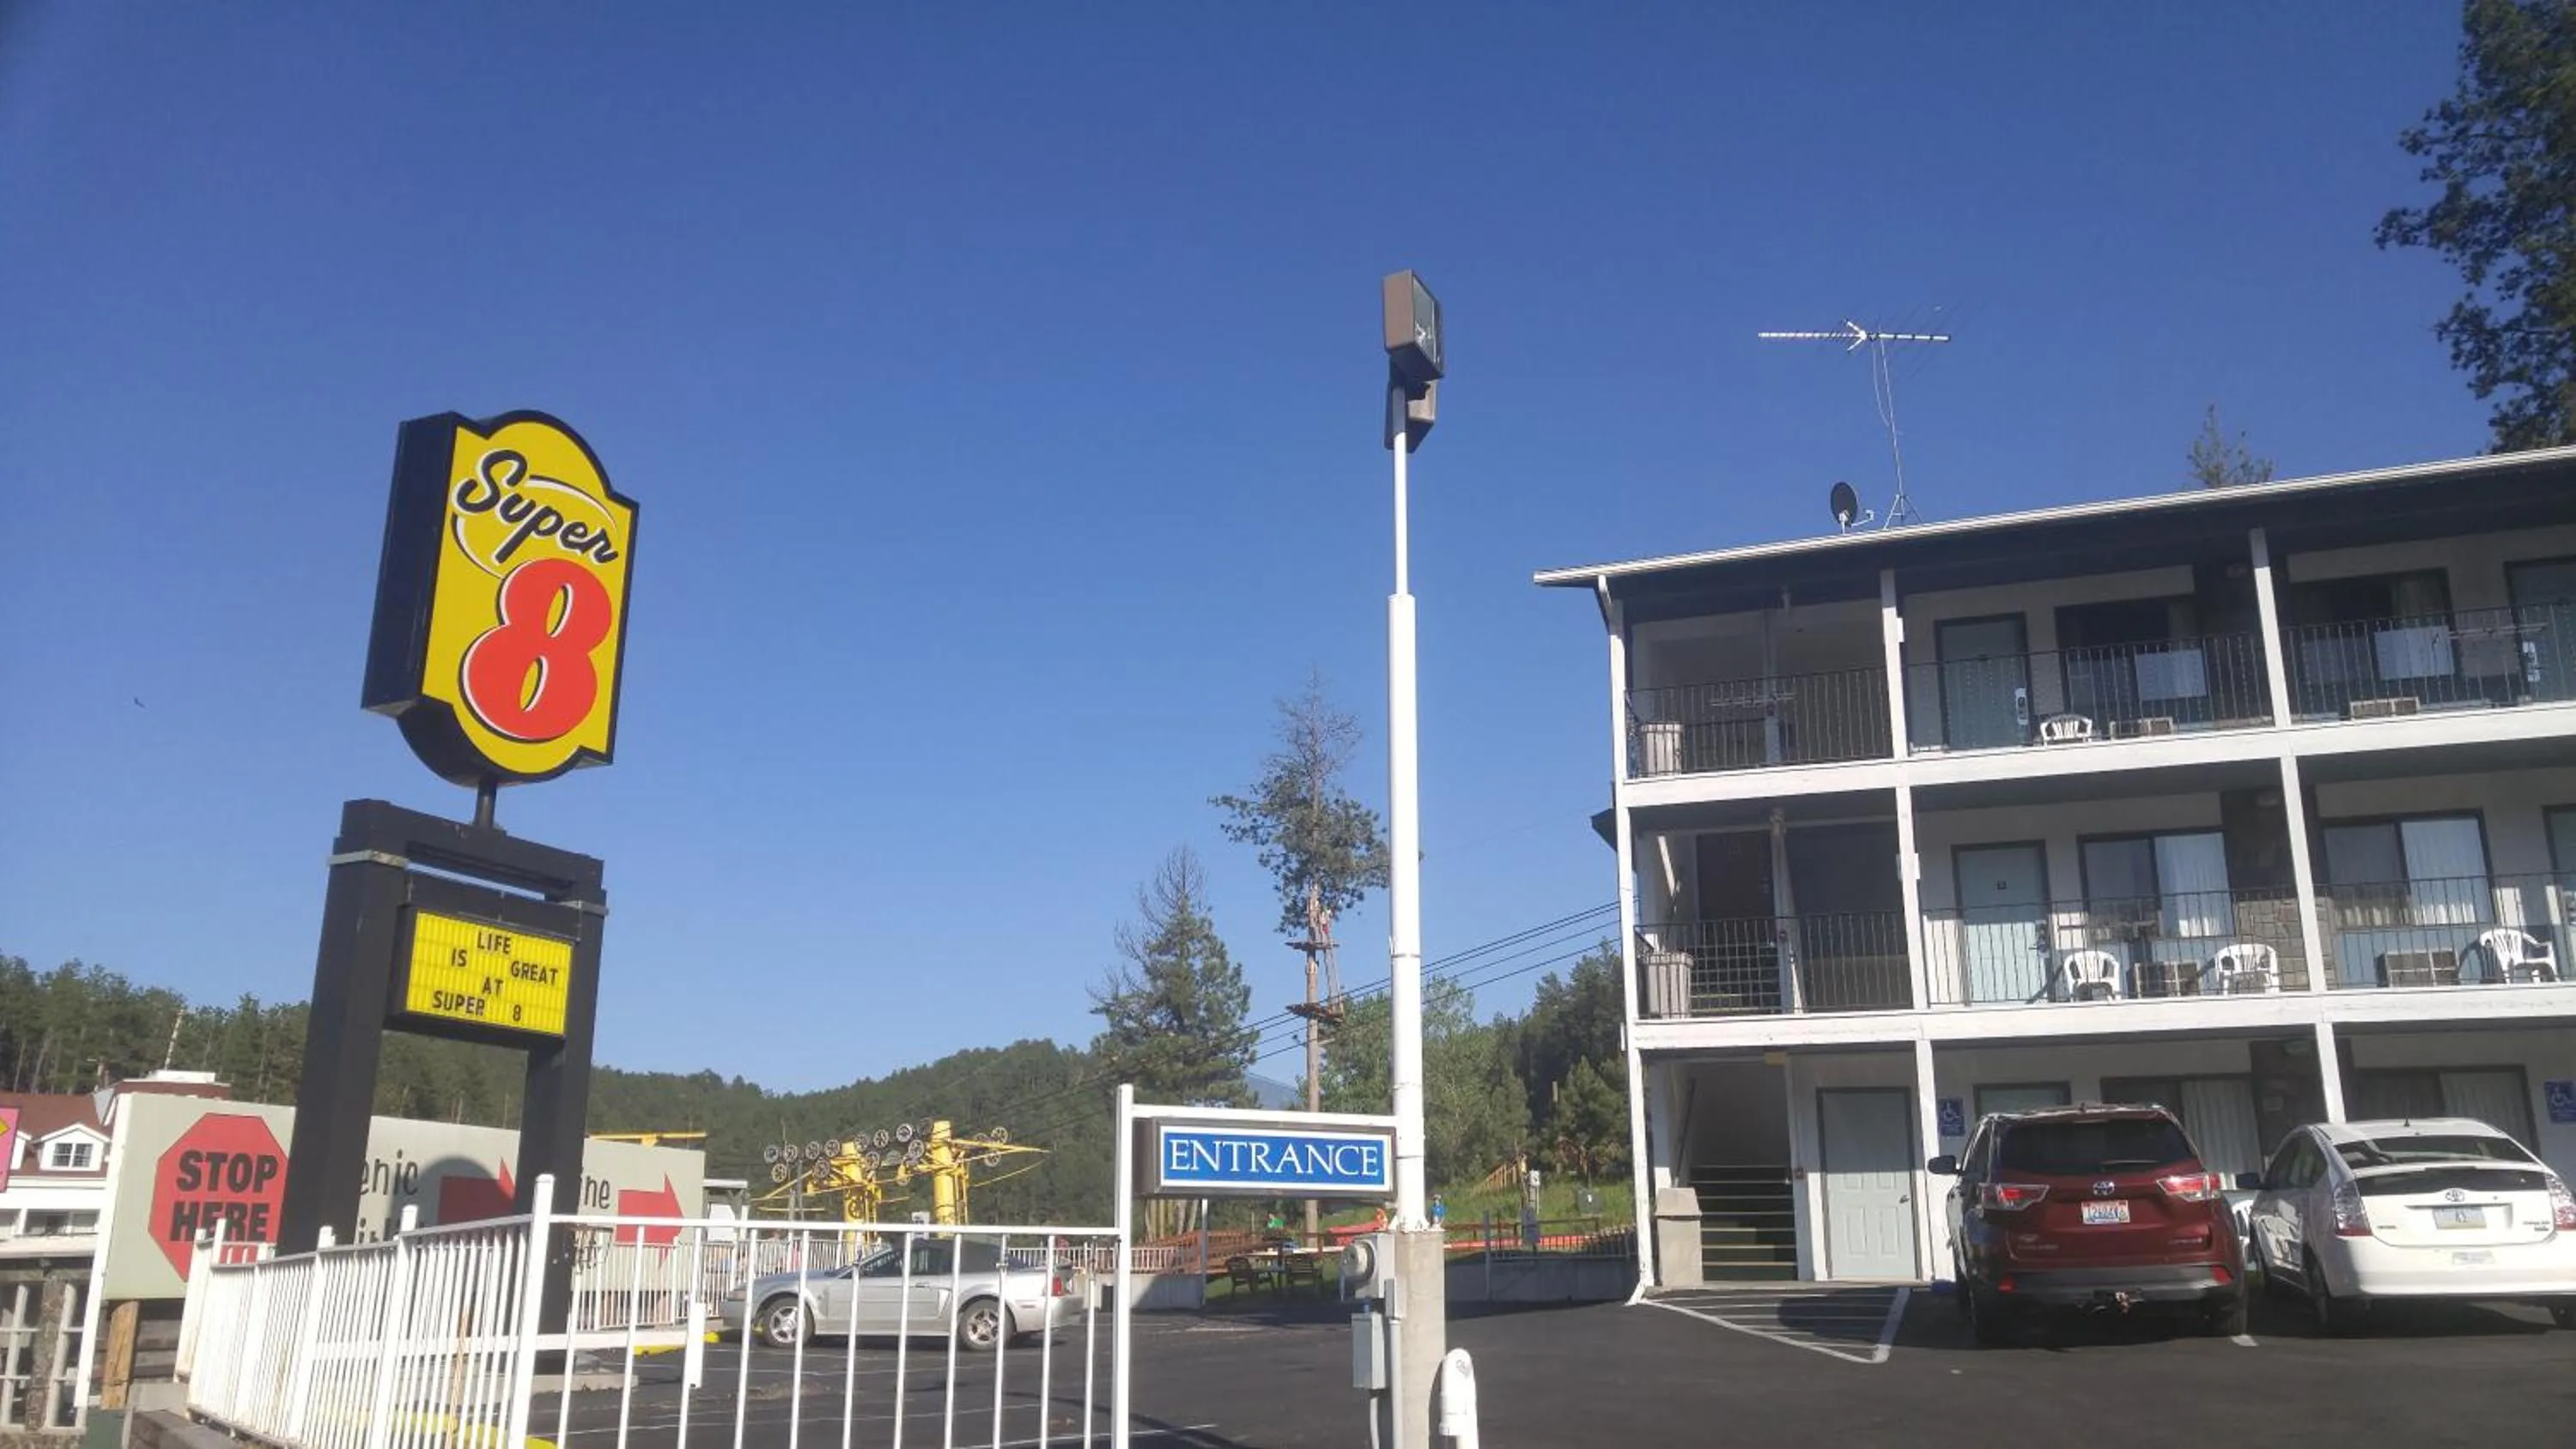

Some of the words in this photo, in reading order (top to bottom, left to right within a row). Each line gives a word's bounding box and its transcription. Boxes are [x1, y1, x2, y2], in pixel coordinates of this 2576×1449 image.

[453, 449, 619, 566] Super
[459, 558, 612, 744] 8
[477, 931, 513, 955] LIFE
[451, 949, 468, 967] IS
[510, 961, 558, 985] GREAT
[432, 990, 485, 1016] SUPER
[513, 1003, 522, 1022] 8
[481, 977, 503, 997] AT
[176, 1149, 279, 1193] STOP
[1169, 1138, 1379, 1177] ENTRANCE
[169, 1200, 270, 1242] HERE
